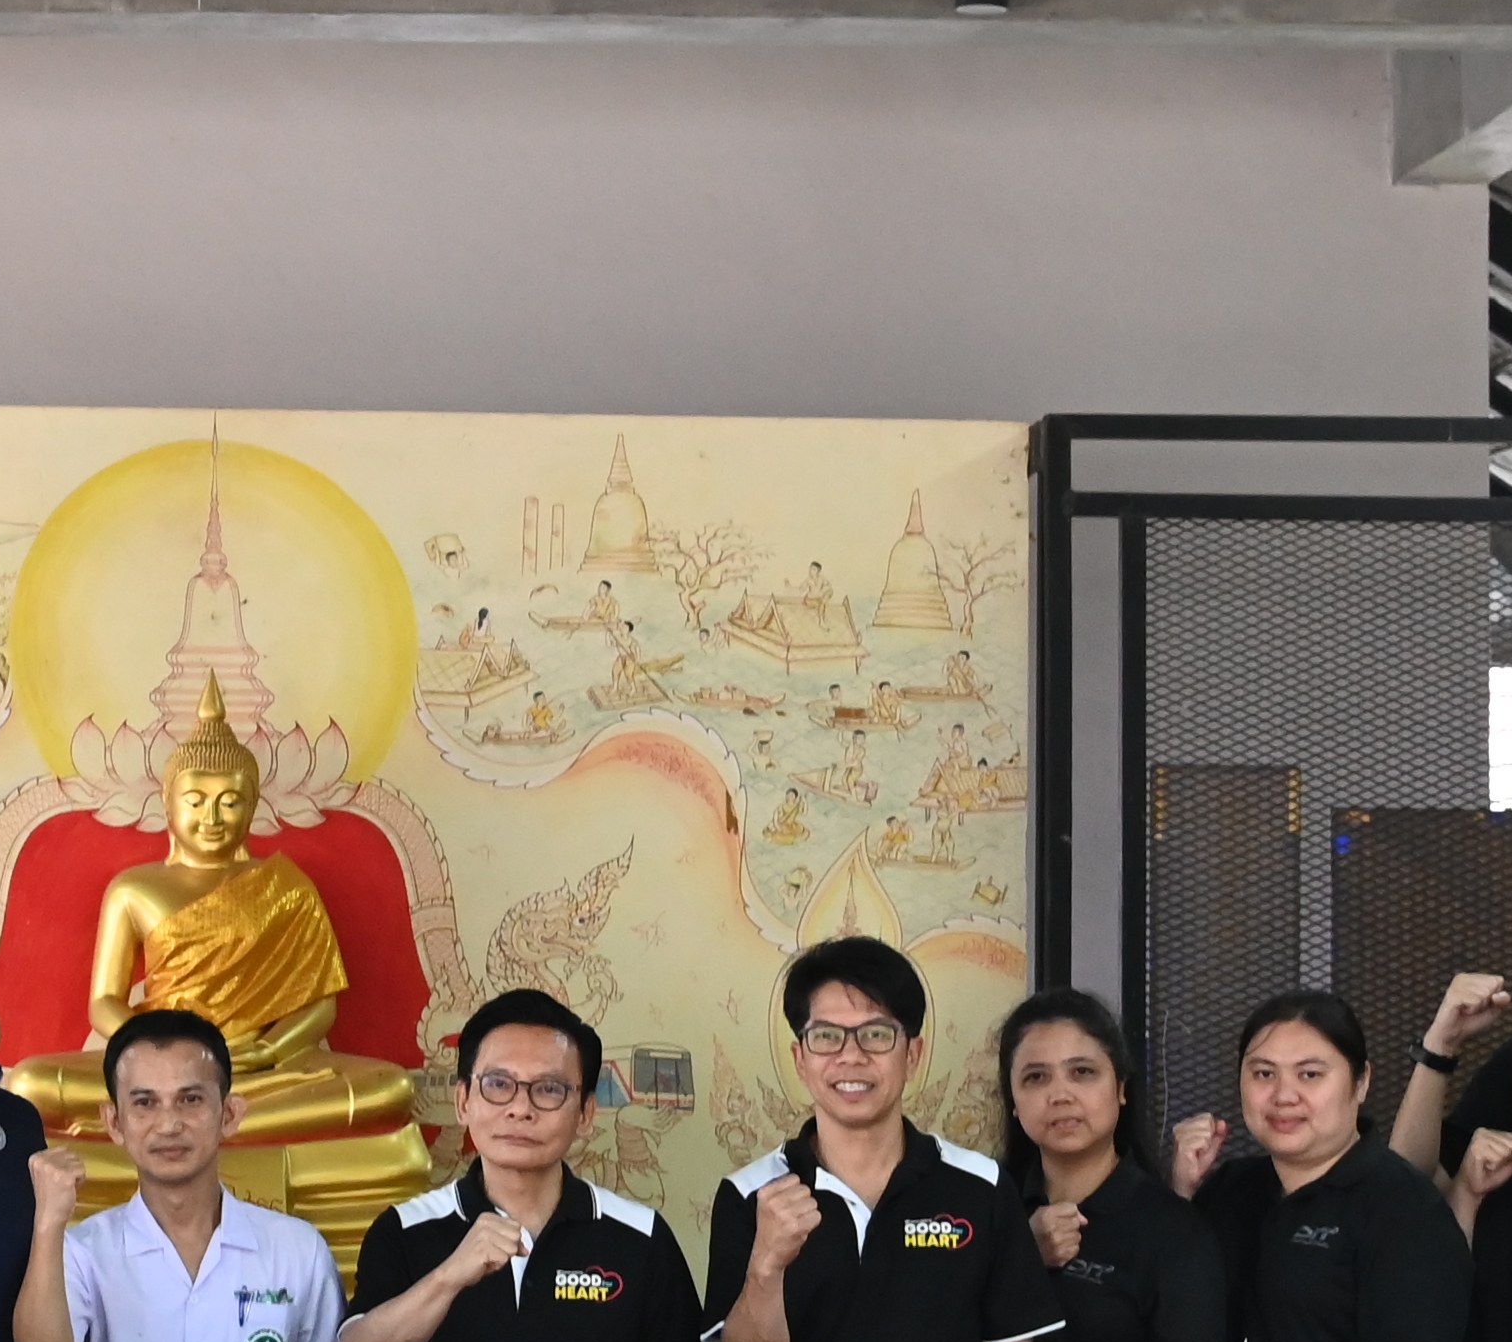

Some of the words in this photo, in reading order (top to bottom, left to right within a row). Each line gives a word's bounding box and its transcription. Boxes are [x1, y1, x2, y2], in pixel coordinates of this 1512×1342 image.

[905, 1222, 952, 1236] GOOD
[904, 1234, 959, 1249] HEART
[555, 1274, 603, 1289] GOOD
[554, 1286, 609, 1301] HEART
